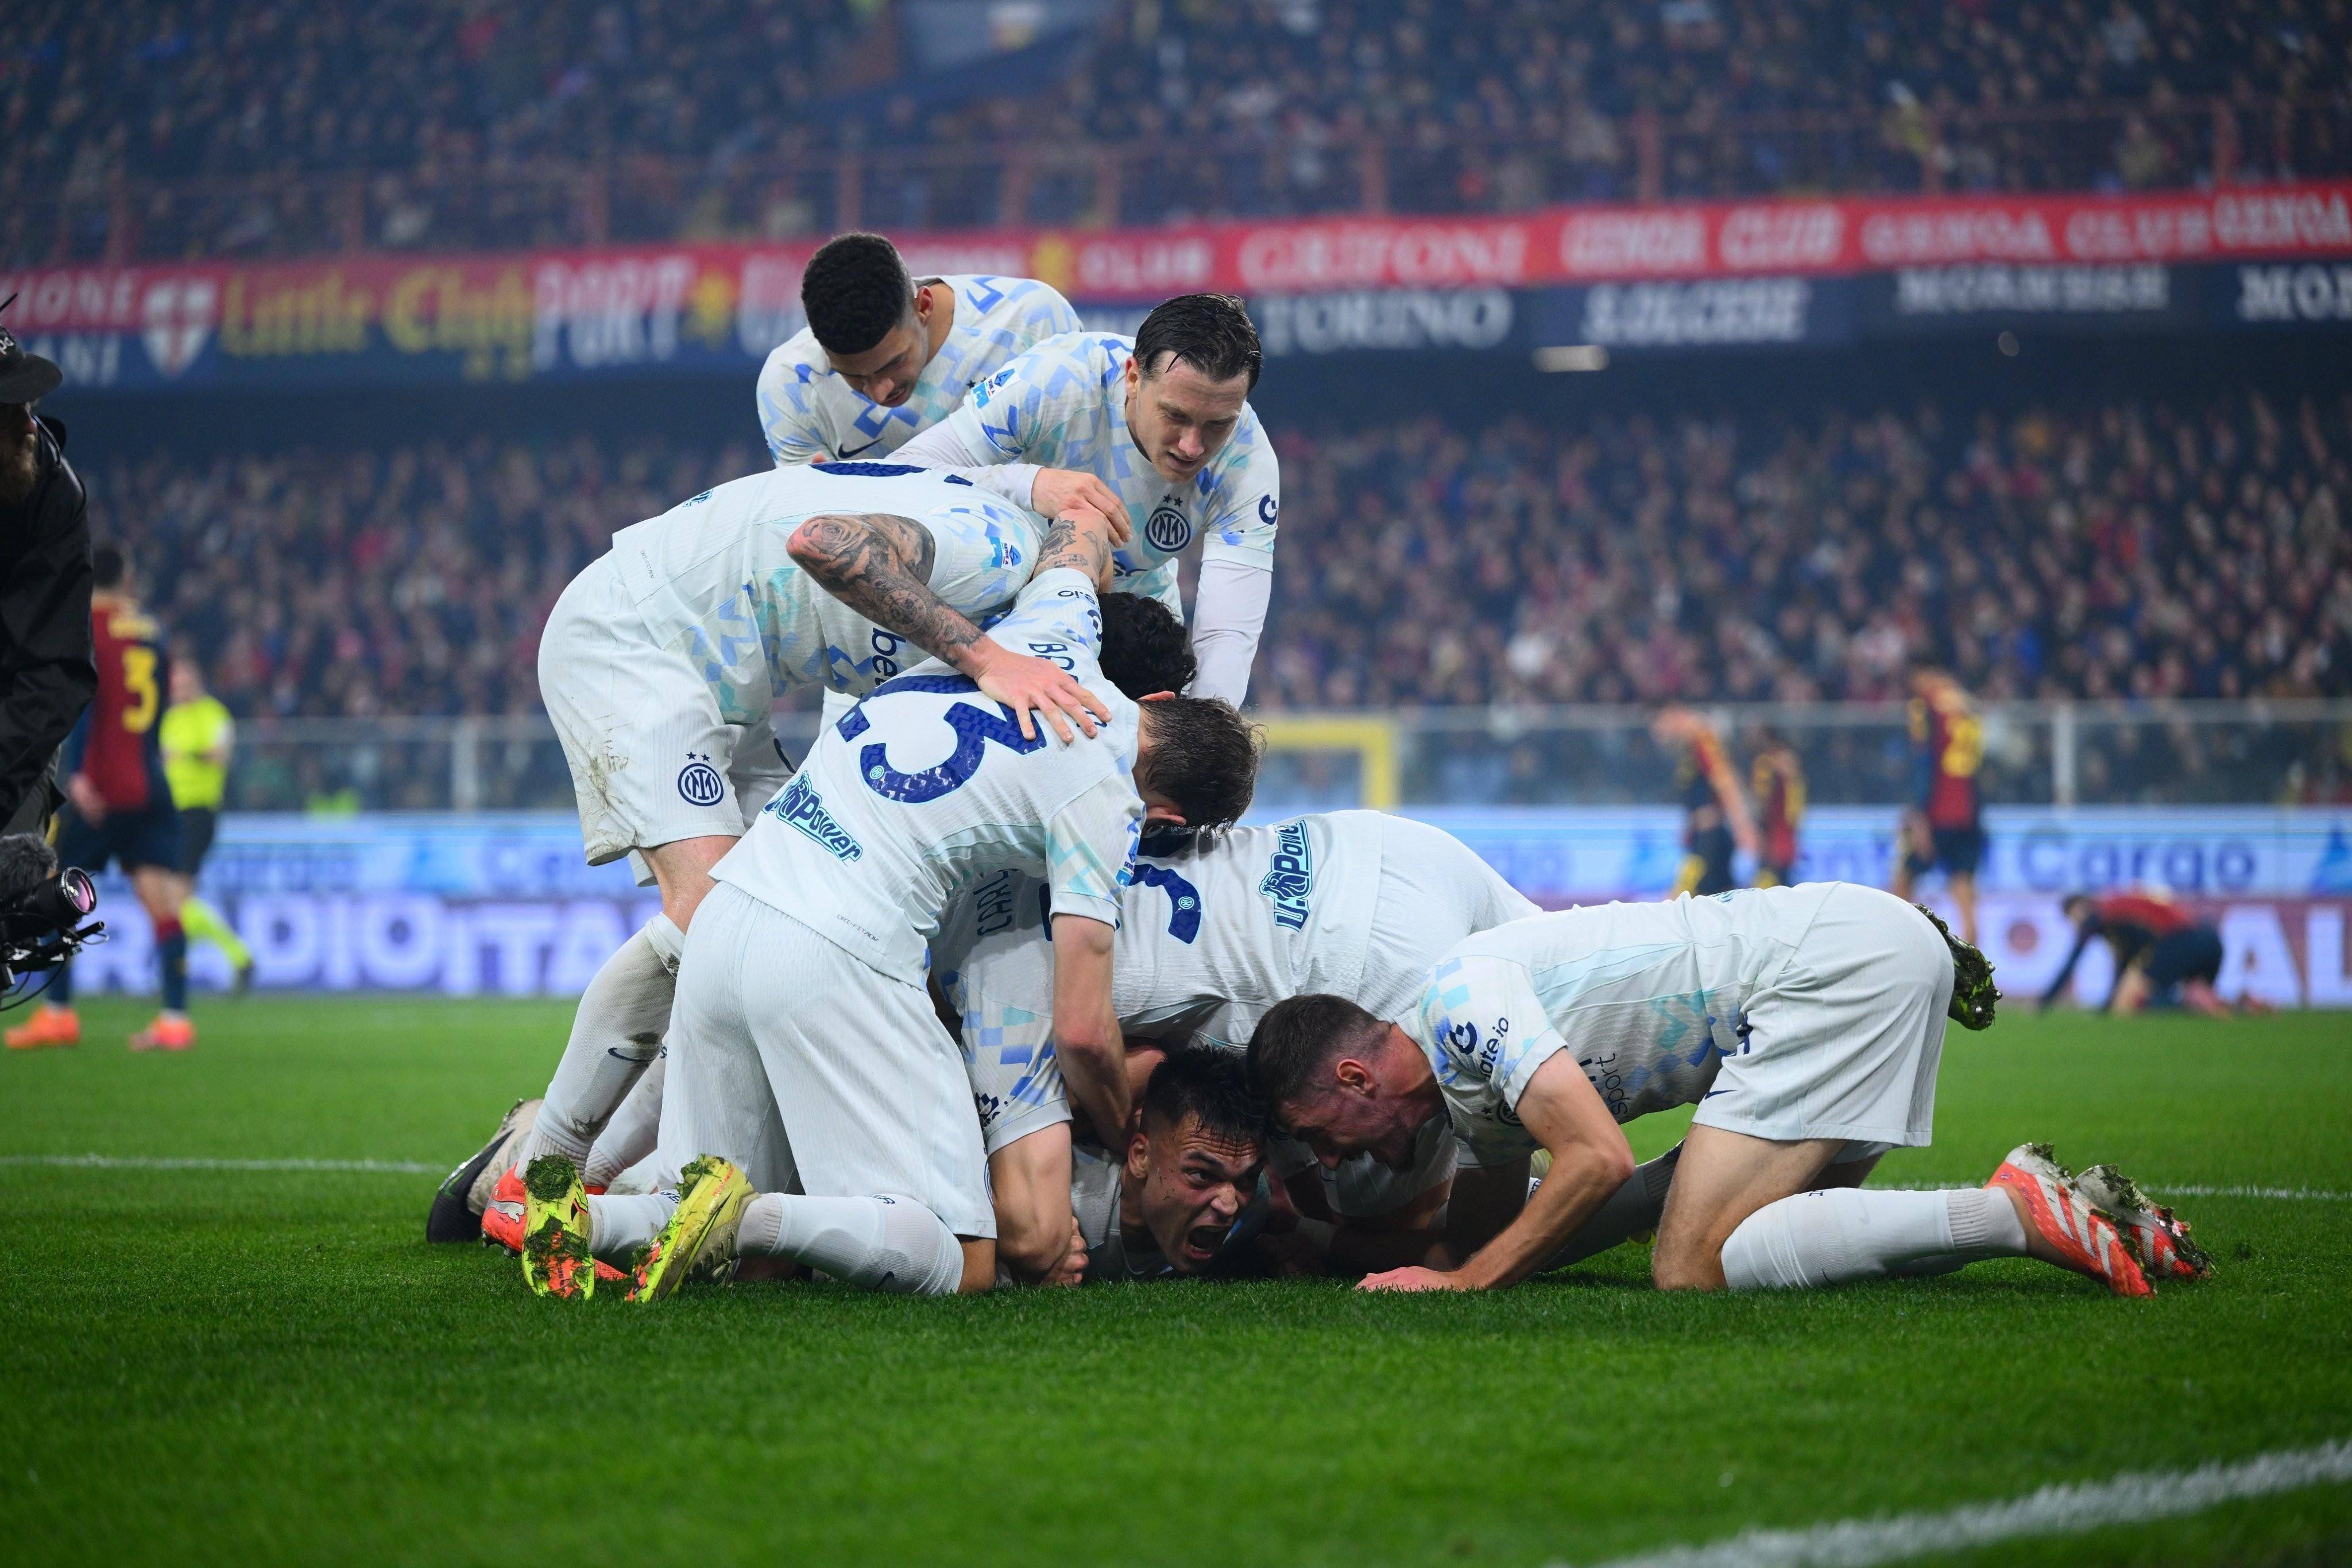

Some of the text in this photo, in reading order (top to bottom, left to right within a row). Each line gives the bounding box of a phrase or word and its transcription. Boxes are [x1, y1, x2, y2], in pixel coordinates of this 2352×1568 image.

[2021, 827, 2257, 895] Cargo
[972, 868, 1023, 936] CARL
[1595, 1052, 1631, 1115] sport
